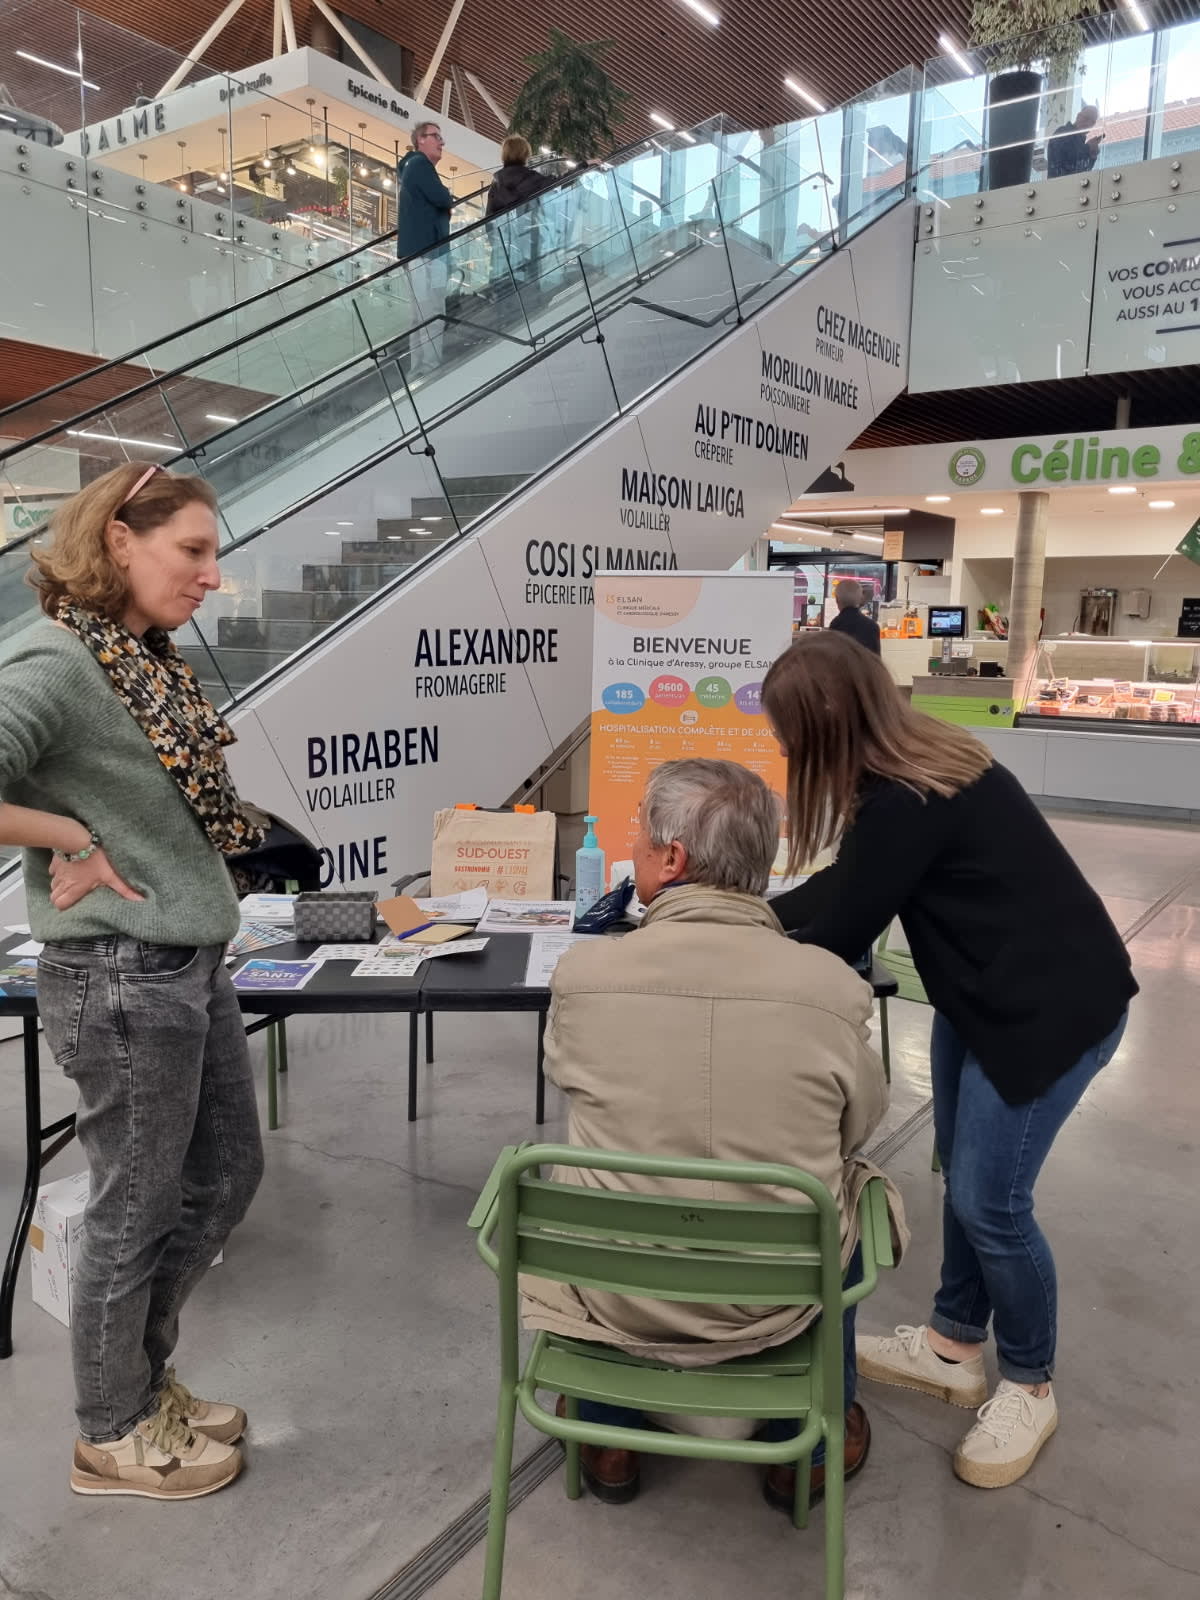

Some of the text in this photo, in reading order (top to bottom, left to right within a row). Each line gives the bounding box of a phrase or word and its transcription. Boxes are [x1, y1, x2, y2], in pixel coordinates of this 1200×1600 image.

[347, 78, 410, 120] Epicerie fine
[1108, 266, 1138, 282] VOS
[1122, 283, 1165, 300] VOUS
[1116, 303, 1159, 322] AUSSI
[1162, 300, 1185, 316] AU
[816, 305, 901, 368] CHEZ MAGENDIE
[815, 337, 845, 363] PRIMEUR
[761, 350, 859, 411] MORILLON MARÉE
[760, 383, 811, 416] POISSONNERIE
[694, 403, 809, 462] AU P'TIT DOLMEN
[694, 438, 734, 466] CRÊPERIE
[1011, 436, 1161, 484] Céline
[1177, 431, 1200, 475] &
[621, 467, 745, 519] MAISON LAUGA
[620, 507, 671, 532] VOLAILLER
[525, 539, 678, 579] COSI SI MANGIA
[525, 579, 576, 605] ÉPICERIE
[414, 628, 558, 668] ALEXANDRE
[633, 636, 752, 655] BIENVENUE
[608, 657, 614, 666] à
[616, 657, 625, 666] la
[627, 657, 664, 669] Clinique
[667, 658, 706, 670] d'Aressy,
[709, 661, 742, 670] groupe
[415, 672, 507, 699] FROMAGERIE
[615, 689, 633, 699] 185
[657, 682, 684, 692] 9600
[706, 683, 719, 693] 45
[747, 690, 762, 700] 14
[600, 723, 676, 735] HOSPITALISATION
[679, 725, 725, 736] COMPLÈTE
[728, 727, 738, 736] ET
[741, 727, 753, 736] DE
[307, 725, 439, 779] BIRABEN
[306, 777, 395, 813] VOLAILLER
[457, 847, 530, 860] SUD-OUEST
